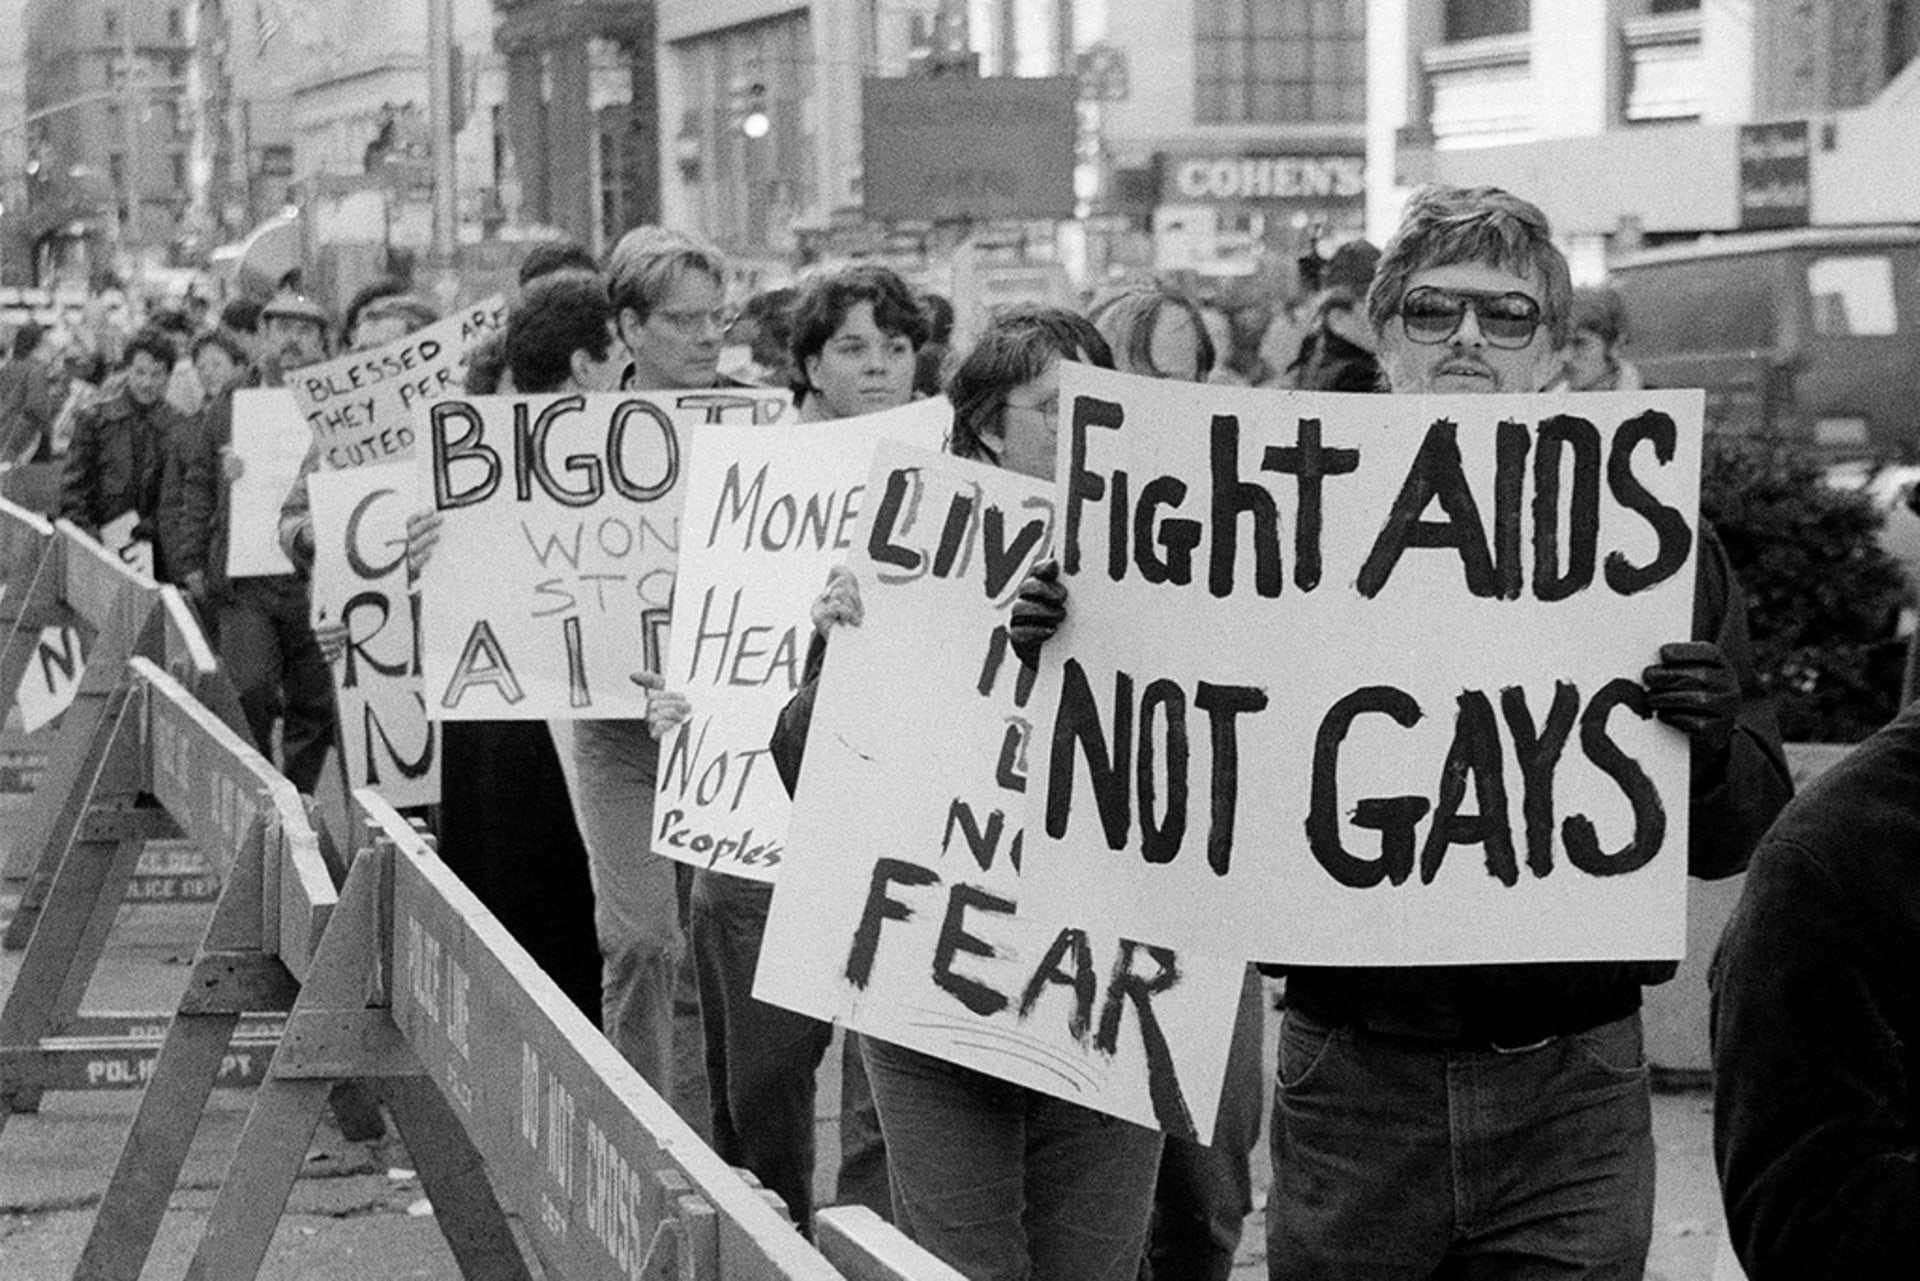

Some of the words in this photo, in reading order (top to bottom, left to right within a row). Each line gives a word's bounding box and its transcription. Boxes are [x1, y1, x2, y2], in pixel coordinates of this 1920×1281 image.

[461, 307, 508, 342] ARE
[307, 398, 375, 438] THEY
[325, 427, 416, 471] CUTED
[1353, 409, 1692, 602] AIDS
[659, 714, 770, 813] NOT
[1045, 658, 1268, 877] NOT
[1304, 679, 1667, 889] GAYS
[942, 797, 1025, 878] N
[845, 857, 1200, 1140] FEAR
